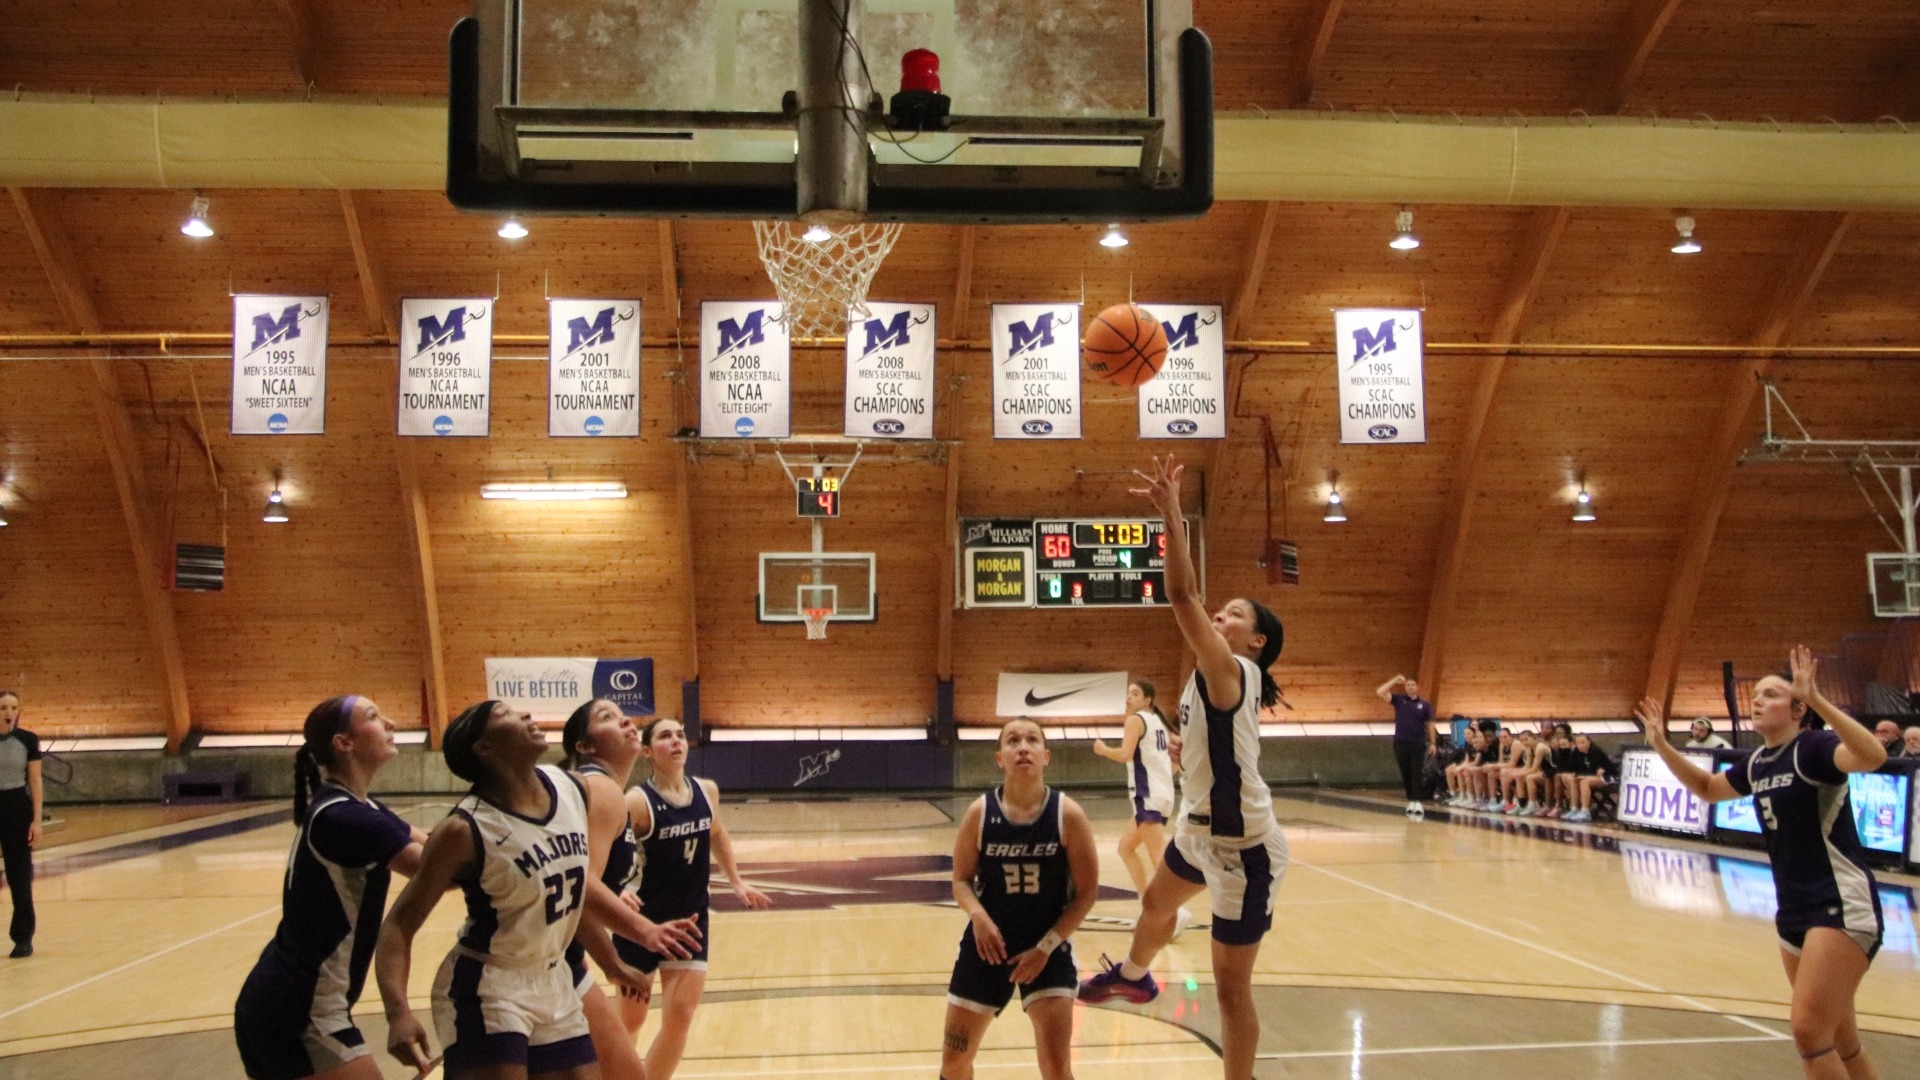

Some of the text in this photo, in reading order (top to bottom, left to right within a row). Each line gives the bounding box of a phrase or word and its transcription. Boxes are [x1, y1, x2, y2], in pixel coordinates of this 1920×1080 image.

[266, 351, 295, 364] 1995
[431, 352, 461, 365] 1996
[580, 353, 609, 366] 2001
[730, 355, 760, 369] 2008
[877, 356, 904, 369] 2008
[1024, 358, 1048, 370] 2001
[1169, 358, 1194, 370] 1996
[244, 366, 315, 376] MEN'S BASKETBALL
[409, 368, 481, 378] MEN'S BASKETBALL
[559, 369, 631, 379] MEN'S BASKETBALL
[709, 371, 781, 381] MEN'S BASKETBALL
[859, 370, 921, 380] MEN'S BASKETBALL
[1006, 371, 1067, 380] MEN'S BASKETBALL
[1154, 371, 1212, 380] EN'S BASKETBALL
[1368, 363, 1393, 375] 1995
[262, 379, 296, 395] NCAA
[430, 380, 458, 392] NCAA
[580, 380, 609, 393] NCAA
[1351, 377, 1411, 386] MEN'S BASKETBALL
[728, 384, 762, 400] NCAA
[876, 382, 903, 396] SCAC
[1024, 383, 1050, 396] SCAC
[1168, 383, 1195, 396] SCAC
[1368, 388, 1394, 402] SCAC
[246, 398, 313, 408] "SWEET SIXTEEN"
[403, 393, 485, 410] TOURNAMENT
[555, 394, 635, 410] TOURNAMENT
[718, 403, 772, 414] "ELITE EIGHT"
[854, 397, 925, 415] CHAMPIONS
[1002, 398, 1072, 414] CHAMPIONS
[1147, 398, 1217, 414] CHAMPIONS
[1348, 403, 1416, 419] CHAMPIONS
[876, 423, 901, 432] SCAC
[1025, 423, 1049, 433] SCAC
[1170, 423, 1194, 432] SCAC
[1371, 428, 1395, 437] SCAC
[806, 478, 838, 492] 7:03
[818, 493, 833, 516] 4
[989, 528, 1033, 537] MILLSAPS
[1041, 524, 1069, 534] HOME
[1092, 523, 1144, 545] 7:03
[992, 536, 1030, 544] MAJORS
[1044, 535, 1071, 559] 60
[977, 558, 1021, 572] MORGAN
[1053, 560, 1075, 568] BONUS
[1093, 555, 1118, 563] PERIOD
[1119, 550, 1132, 568] 4
[997, 572, 1003, 582] &
[1089, 573, 1114, 581] PLAYER
[977, 582, 1022, 596] MORGAN
[1050, 580, 1062, 598] 0
[1073, 583, 1082, 597] 3
[1143, 582, 1153, 597] 3
[495, 681, 578, 698] LIVE BETTER
[1155, 729, 1167, 751] 10
[1628, 758, 1651, 778] THE
[1752, 773, 1794, 793] AGLES
[1624, 784, 1699, 824] DOME
[1759, 796, 1779, 831] 3
[658, 818, 712, 840] EAGLES
[514, 832, 588, 879] MAJORS
[683, 839, 698, 865] 4
[985, 843, 1059, 857] EAGLES
[1002, 863, 1040, 894] 23
[543, 866, 585, 926] 23
